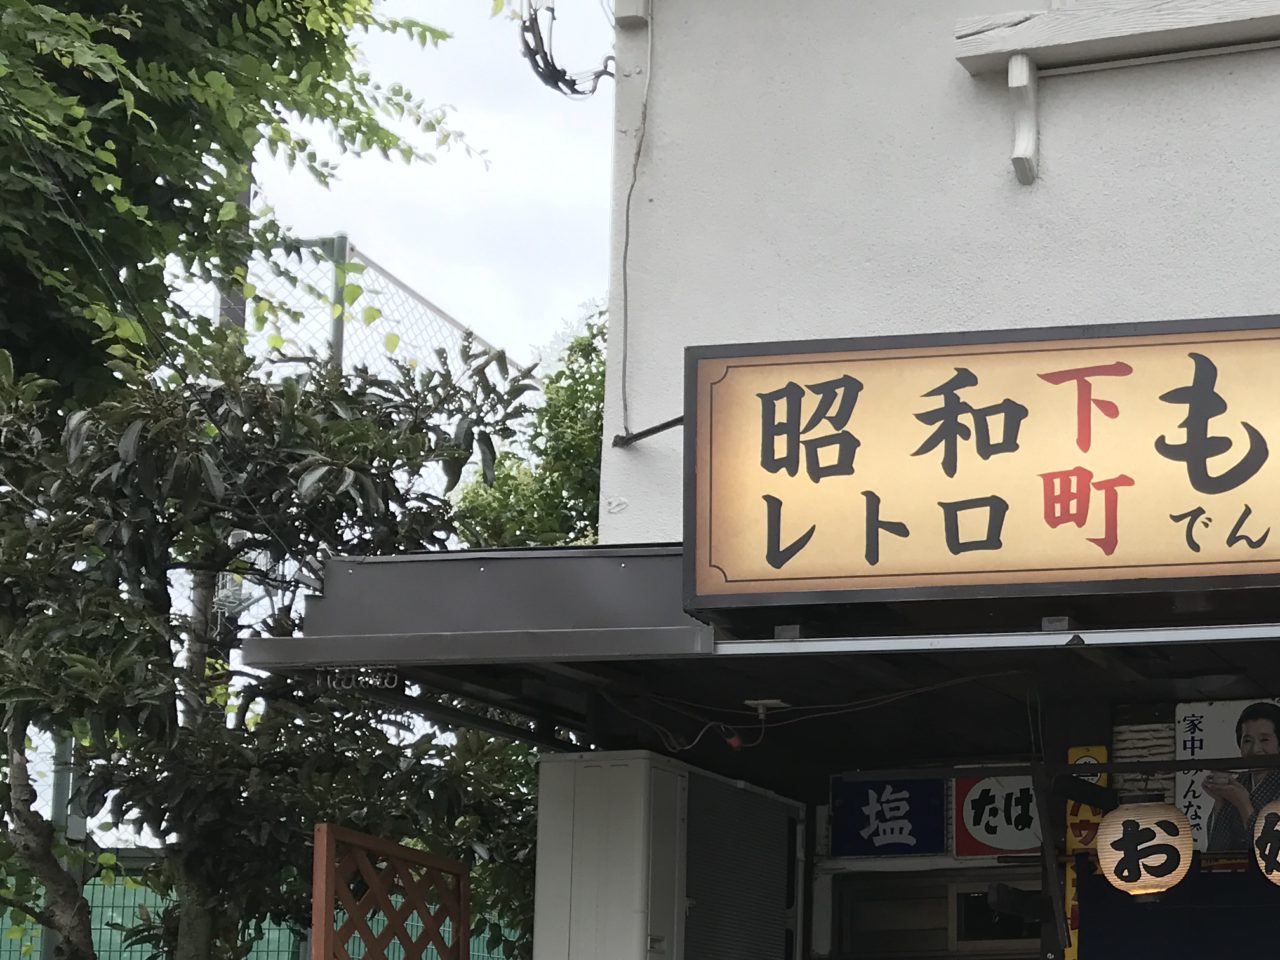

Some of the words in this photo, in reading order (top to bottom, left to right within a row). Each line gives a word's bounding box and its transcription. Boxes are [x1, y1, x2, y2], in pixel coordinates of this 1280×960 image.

[755, 367, 1030, 484] 昭和
[1034, 361, 1136, 557] 下町
[761, 490, 1010, 570] レトロ
[858, 783, 917, 848] 塩
[1110, 819, 1180, 882] お
